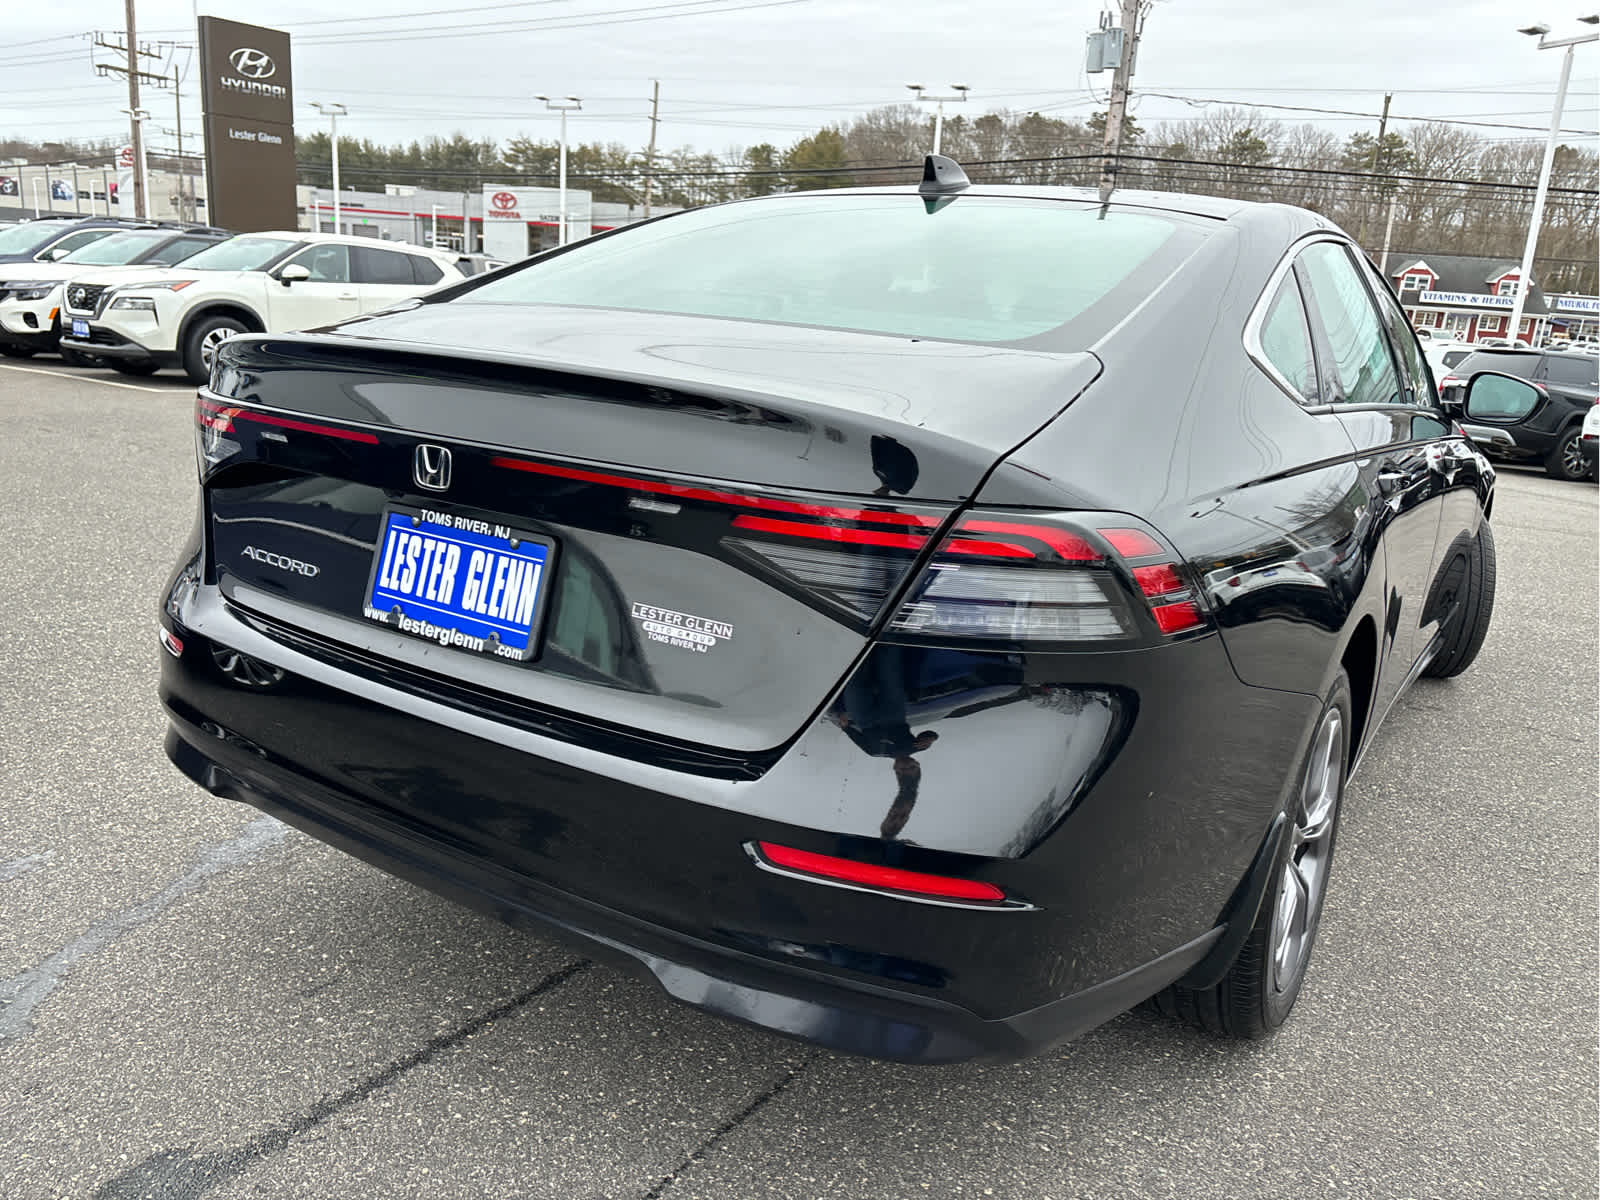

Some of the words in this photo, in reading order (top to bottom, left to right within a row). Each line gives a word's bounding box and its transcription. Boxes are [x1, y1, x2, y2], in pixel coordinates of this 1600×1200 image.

[220, 76, 287, 98] HYUNDAI
[229, 128, 256, 141] Lester
[258, 132, 282, 145] Glenn
[488, 210, 521, 219] TOYOTA
[1423, 292, 1467, 304] VITAMINS
[1470, 295, 1479, 304] &
[1482, 296, 1514, 306] HERBS
[1560, 299, 1590, 309] NATURAL
[421, 509, 453, 527] TOMS
[454, 516, 492, 537] RIVER,
[495, 524, 511, 540] NJ
[240, 545, 320, 577] ACCORD
[379, 529, 461, 606] LESTER
[461, 549, 542, 627] GLENN
[631, 604, 683, 626] LESTER
[685, 617, 733, 638] GLENN
[645, 622, 672, 636] AUTO
[675, 629, 714, 645] GROUP
[647, 631, 670, 644] TOMS
[670, 637, 696, 652] RIVER,
[696, 643, 708, 653] NJ
